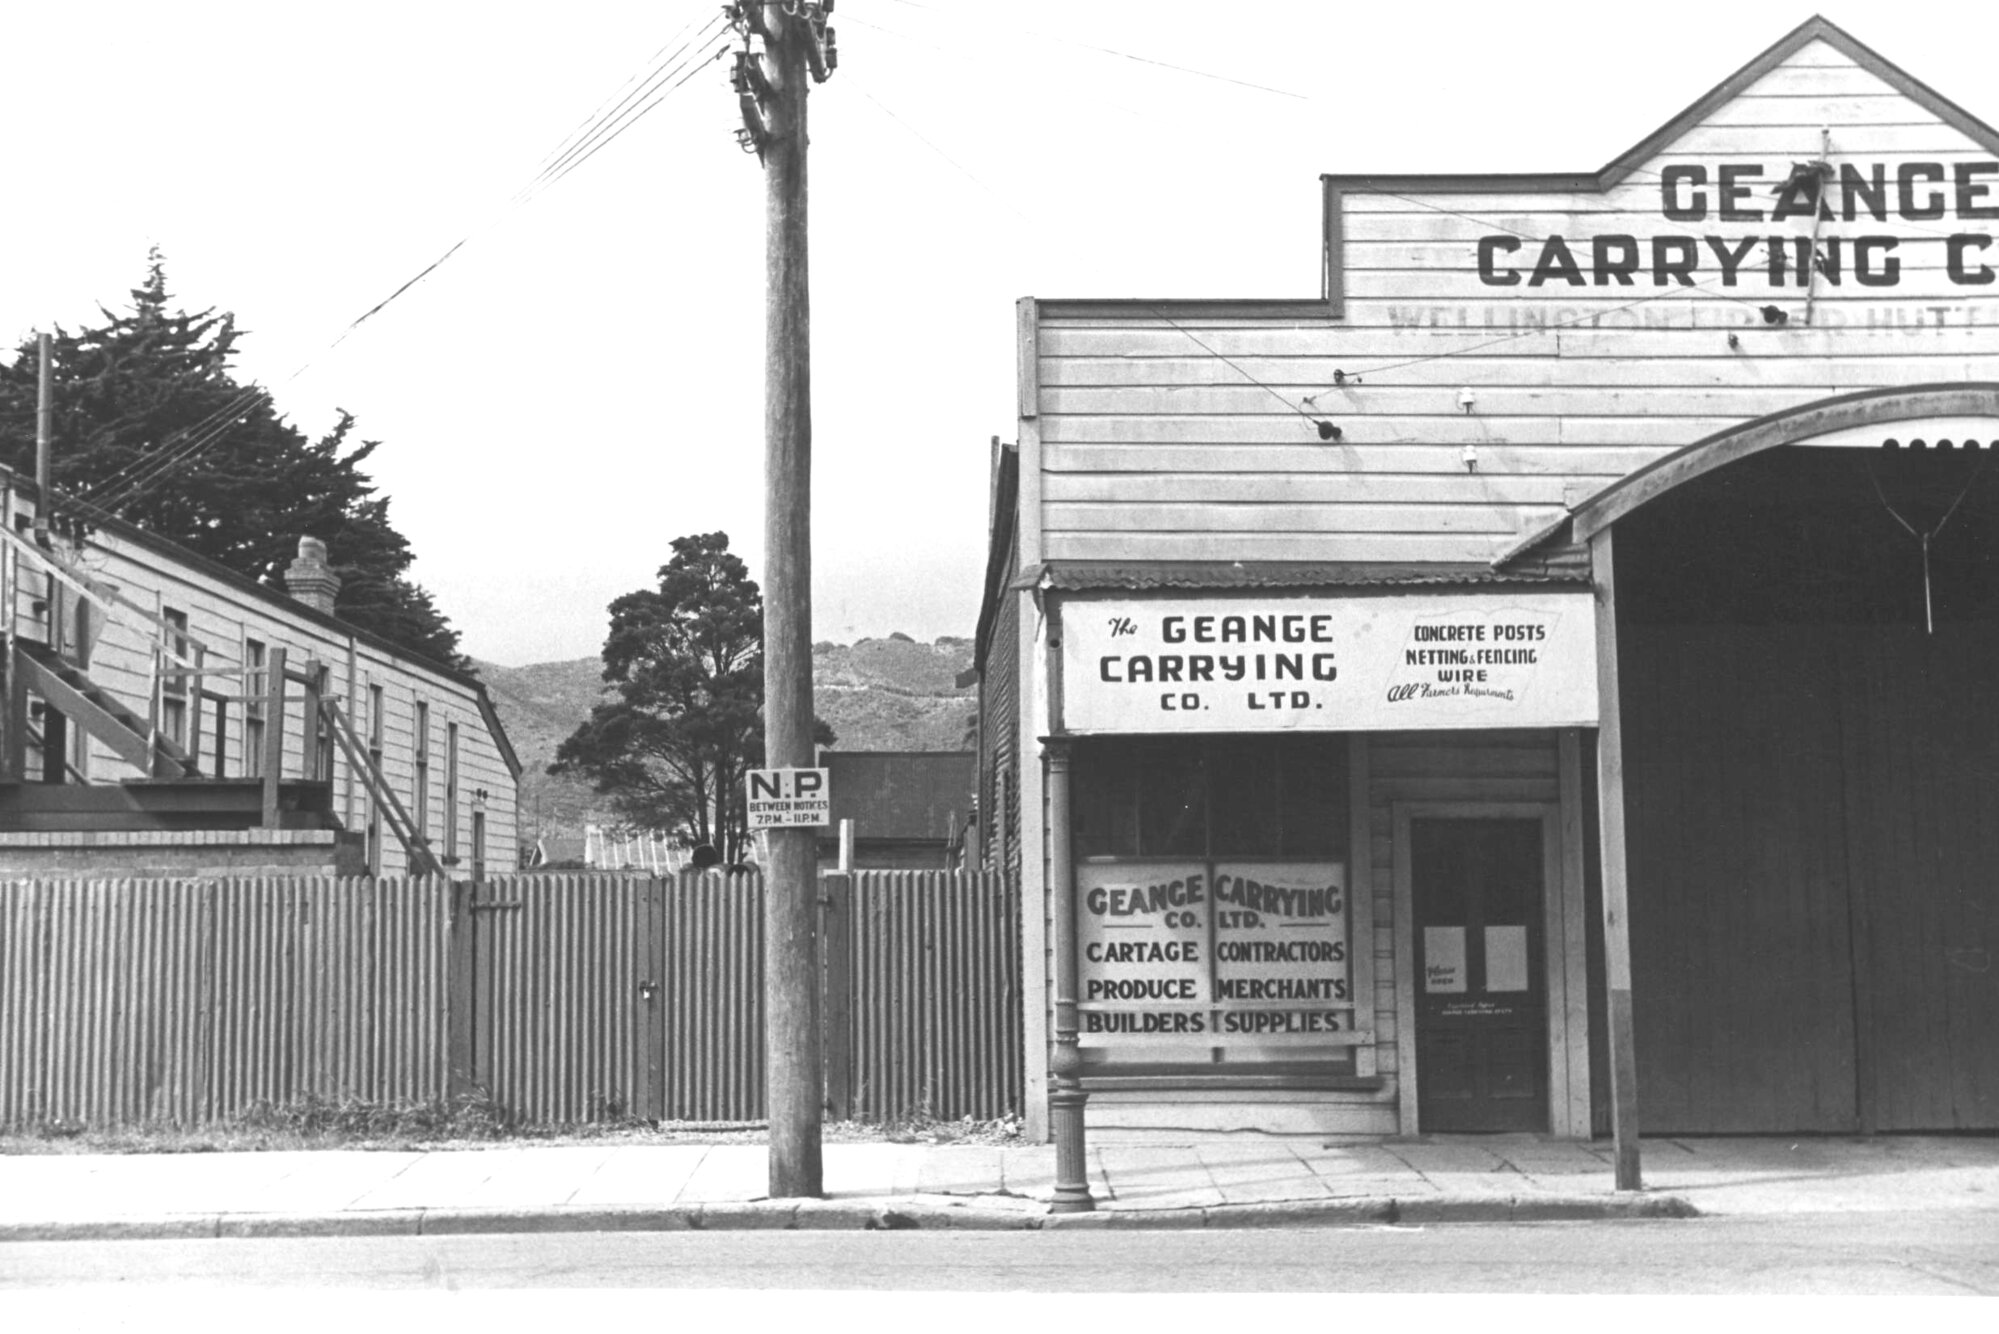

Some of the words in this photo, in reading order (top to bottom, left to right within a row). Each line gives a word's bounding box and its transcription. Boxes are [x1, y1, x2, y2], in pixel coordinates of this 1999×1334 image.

[1661, 162, 1999, 222] GEANGE
[1478, 234, 1900, 287] CARRYING
[1108, 617, 1138, 638] The
[1162, 614, 1334, 644] GEANGE
[1414, 624, 1485, 642] CONCRETE
[1493, 624, 1546, 641] POSTS
[1100, 653, 1338, 683] CARRYING
[1437, 669, 1488, 683] WIRE
[1160, 692, 1210, 711] CO.
[1247, 691, 1323, 711] LTD.
[1387, 682, 1420, 703] All
[749, 801, 792, 813] BETWEEN
[793, 800, 828, 811] NOTICES
[1087, 874, 1204, 916] GEANGE
[1216, 875, 1341, 917] CARRYING
[1165, 911, 1202, 929] CO.
[1219, 910, 1265, 929] LTD.
[1086, 942, 1199, 963] CARTAGE
[1217, 941, 1344, 962] CONTRACTORS
[1087, 979, 1197, 1000] PRODUCE
[1218, 979, 1346, 999] MERCHANTS
[1087, 1012, 1205, 1033] BUILDERS
[1224, 1012, 1339, 1033] SUPPLIES
